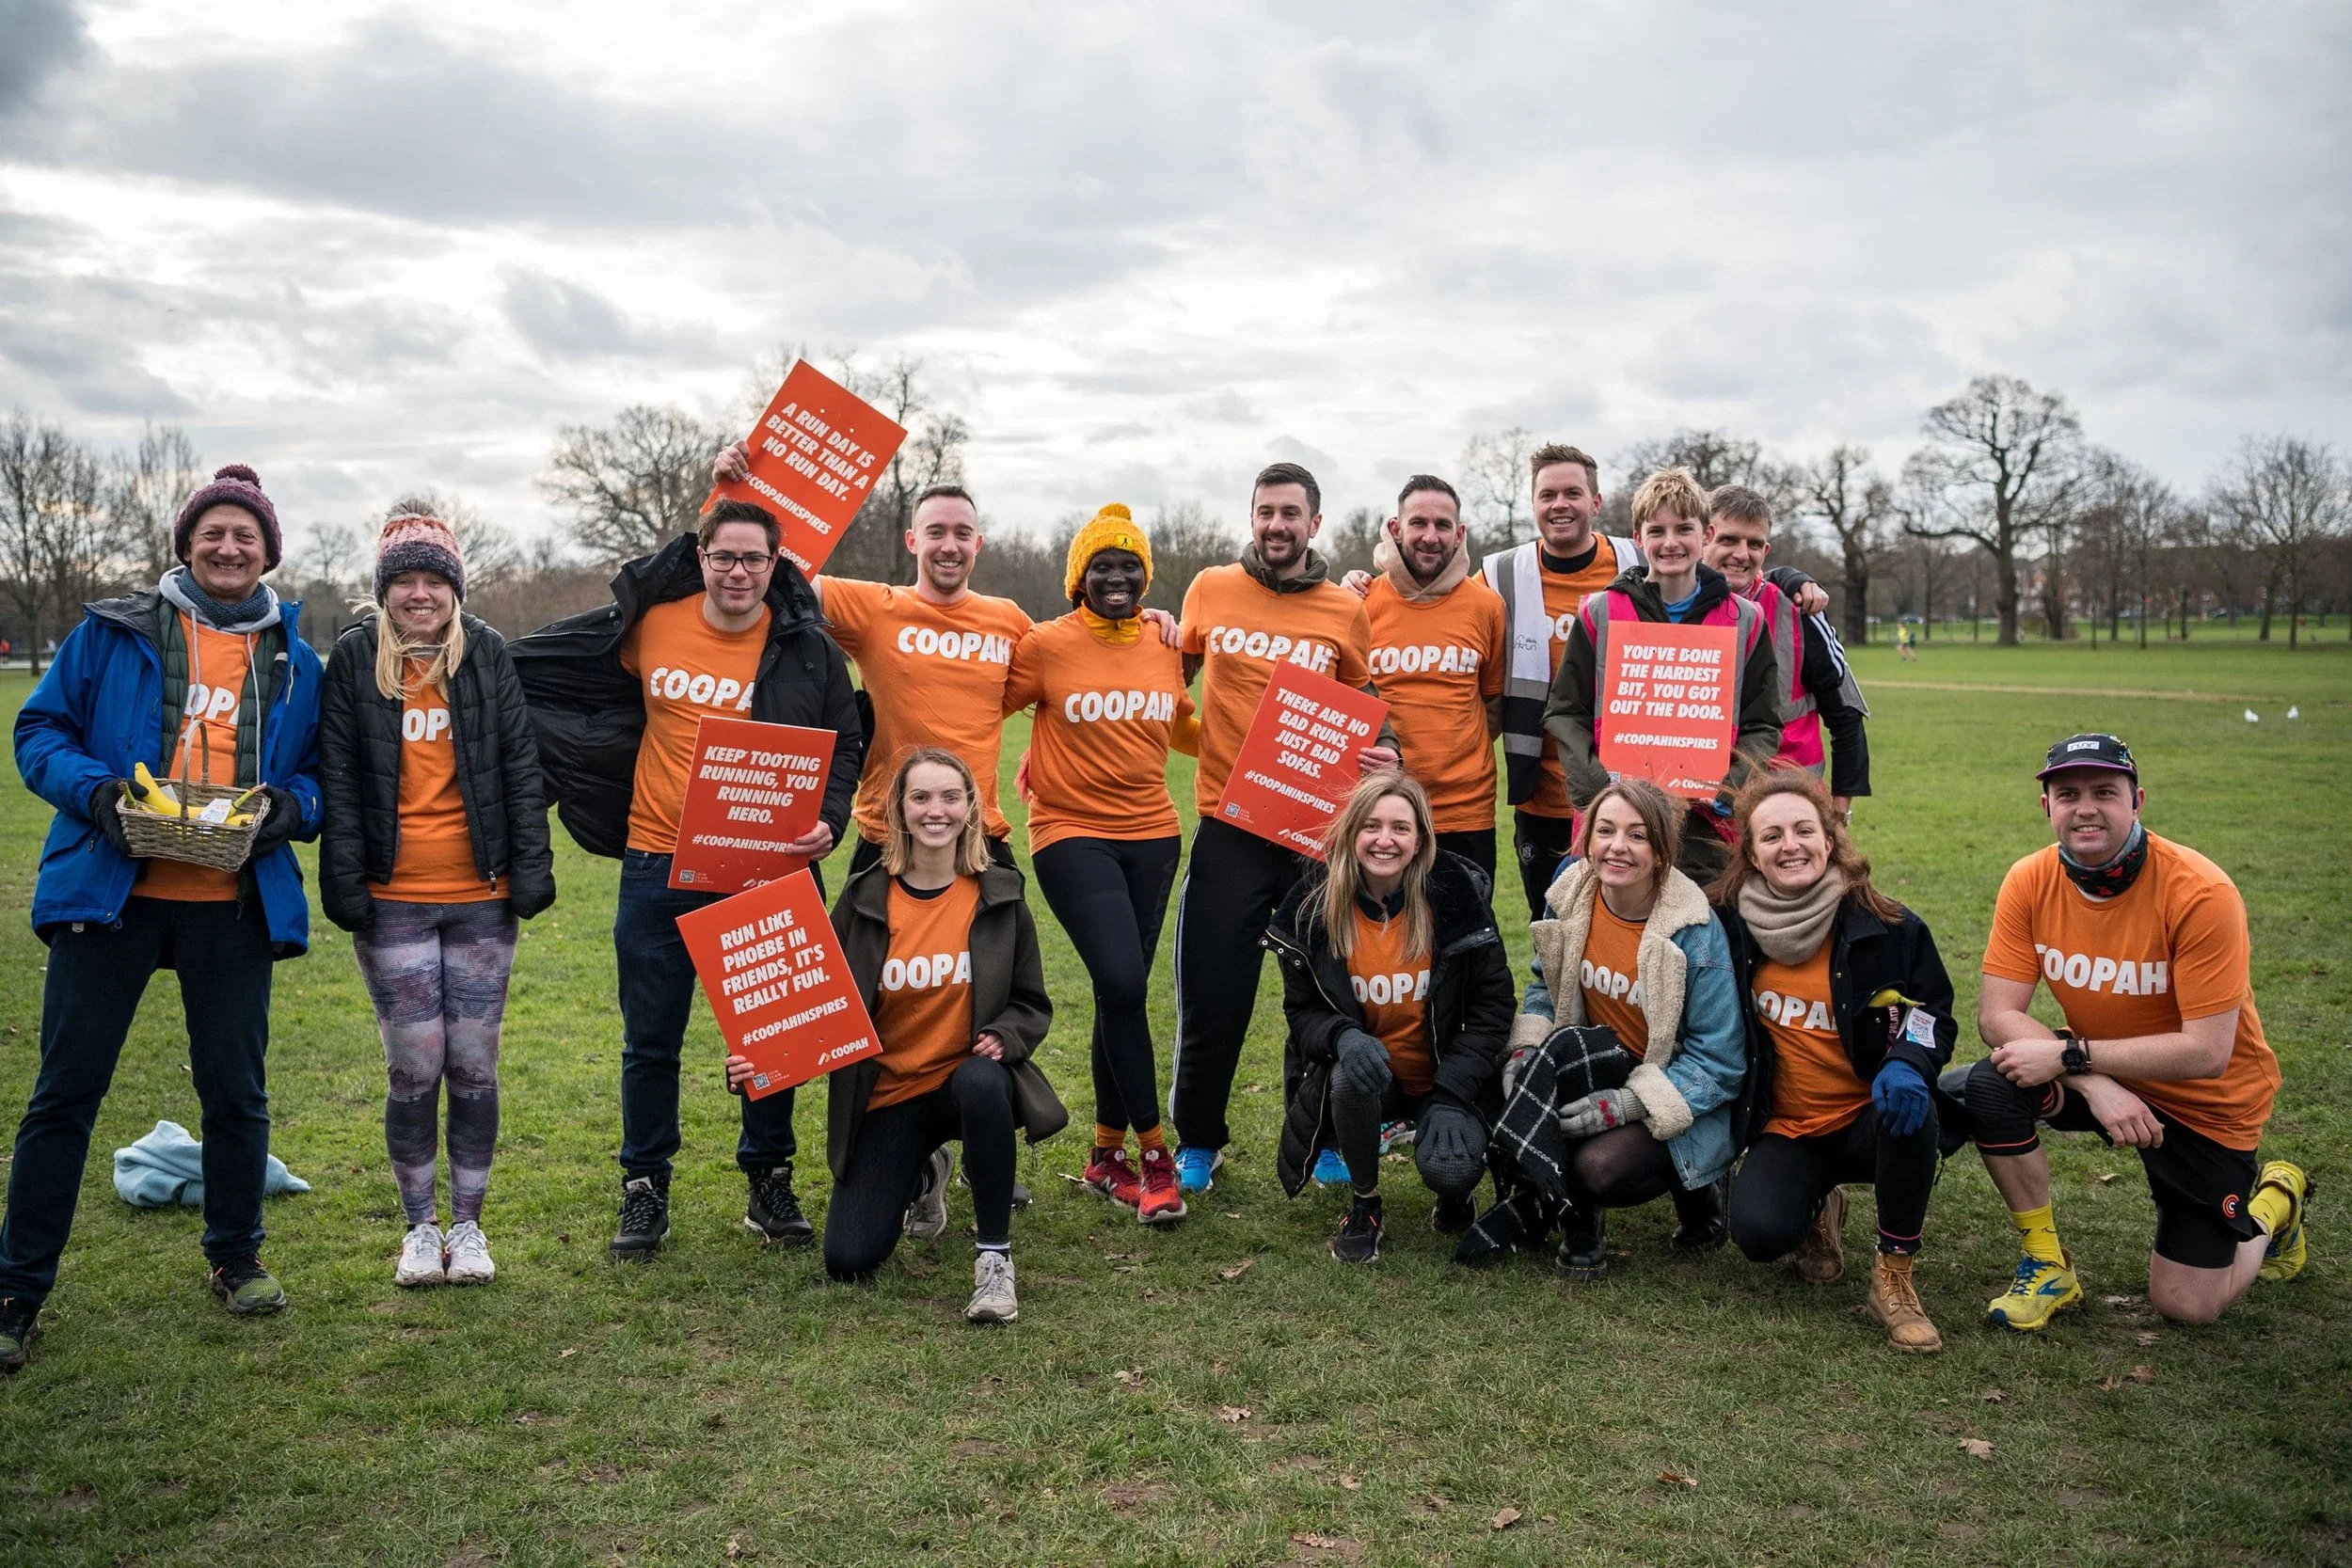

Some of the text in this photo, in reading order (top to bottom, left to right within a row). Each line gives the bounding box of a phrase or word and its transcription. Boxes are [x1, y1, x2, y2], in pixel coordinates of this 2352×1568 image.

[765, 414, 869, 490] BETTER THAN A
[782, 403, 877, 468] A RUN DAY IS
[762, 436, 850, 501] NO RUN DAY.
[744, 471, 832, 535] #COOPAHINSPIRES
[778, 546, 812, 572] COOPAH
[898, 626, 1012, 666] COOPAH
[1210, 626, 1334, 673] COOPAH
[1369, 645, 1478, 674] COOPAH
[1623, 644, 1722, 664] YOU'VE DONE
[1617, 681, 1721, 701] BIT, YOU GOT
[1621, 663, 1721, 682] THE HARDEST
[184, 684, 240, 724] OP
[1065, 690, 1173, 723] COOPAH
[1275, 688, 1370, 737] THERE ARE NO
[1610, 700, 1724, 721] OUT THE DOOR.
[402, 708, 453, 741] OP
[1278, 709, 1349, 752] BAD RUNS,
[1613, 733, 1718, 750] #COOPAHINSPIRES
[704, 745, 821, 772] KEEP TOOTING
[1275, 730, 1341, 765] JUST BAD
[1277, 751, 1322, 780] SOFAS.
[699, 765, 819, 791] RUNNING, YOU
[717, 786, 793, 807] RUNNING
[1244, 769, 1337, 815] #COOPAHINSPIRES
[727, 806, 774, 824] HERO.
[1291, 832, 1324, 851] COOPAH
[720, 909, 794, 950] RUN LIKE
[723, 927, 807, 973] PHOEBE IN
[722, 943, 826, 996] FRIENDS, IT'S
[878, 952, 973, 991] OOPA
[733, 966, 831, 1015] REALLY FUN.
[742, 996, 849, 1046] #COOPAHINSPIRES
[1752, 989, 1838, 1031] OPA
[831, 1037, 868, 1059] COOPAH
